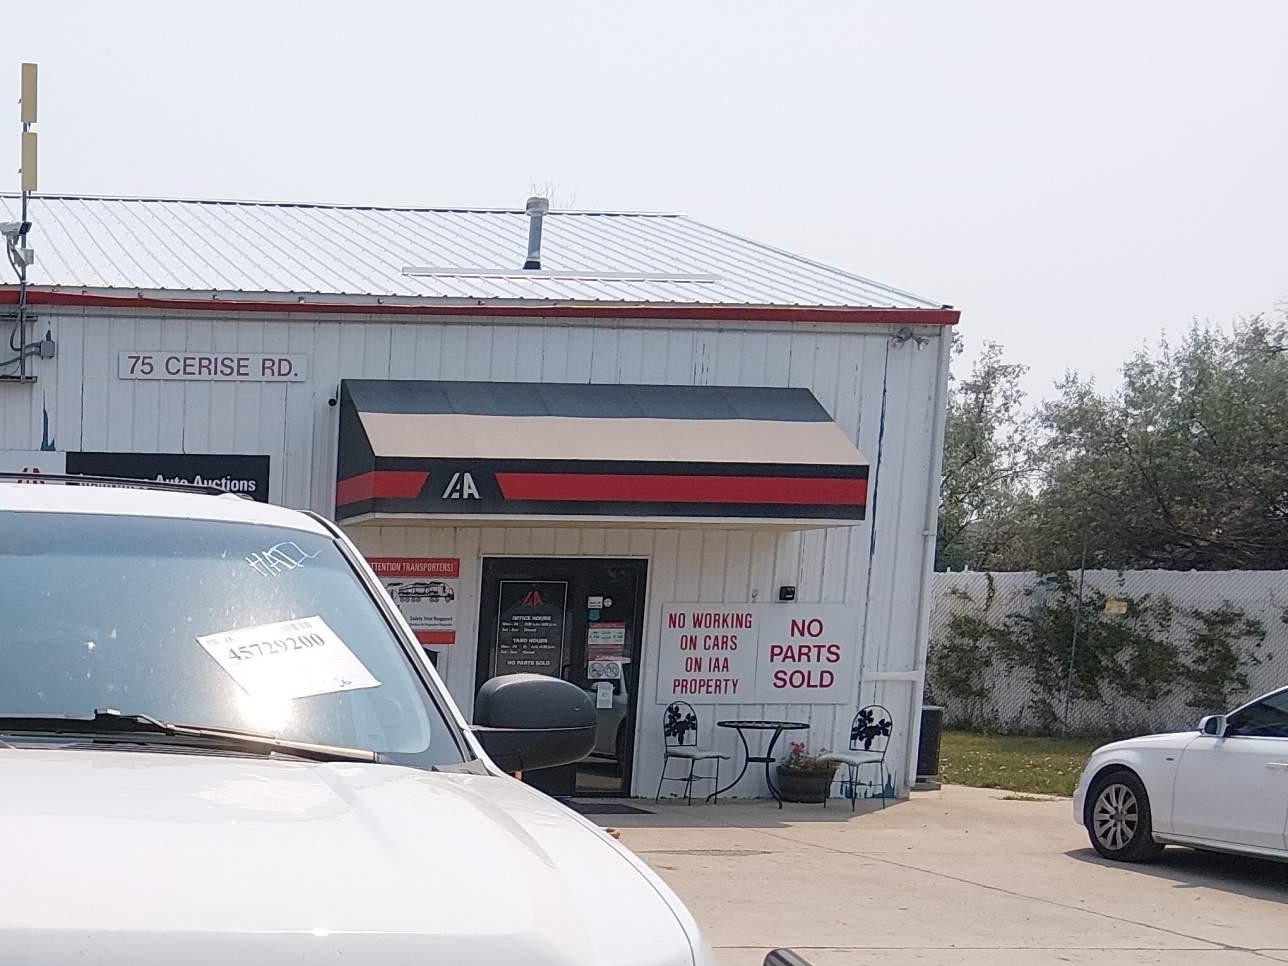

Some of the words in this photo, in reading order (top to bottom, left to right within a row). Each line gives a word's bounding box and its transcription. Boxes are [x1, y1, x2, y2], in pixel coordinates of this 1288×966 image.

[127, 355, 154, 375] 75
[165, 356, 250, 377] CERISE
[261, 357, 298, 378] RD.
[193, 474, 257, 492] Auctions
[370, 562, 401, 572] TTENTION
[668, 612, 686, 629] NO
[692, 612, 753, 629] WORKING
[790, 618, 824, 638] NO
[228, 633, 326, 661] 45729200
[680, 635, 697, 651] ON
[703, 635, 738, 651] CARS
[770, 644, 841, 663] PARTS
[685, 656, 702, 673] ON
[708, 657, 729, 673] IAA
[672, 678, 740, 695] PROPERTY
[772, 669, 835, 689] SOLD
